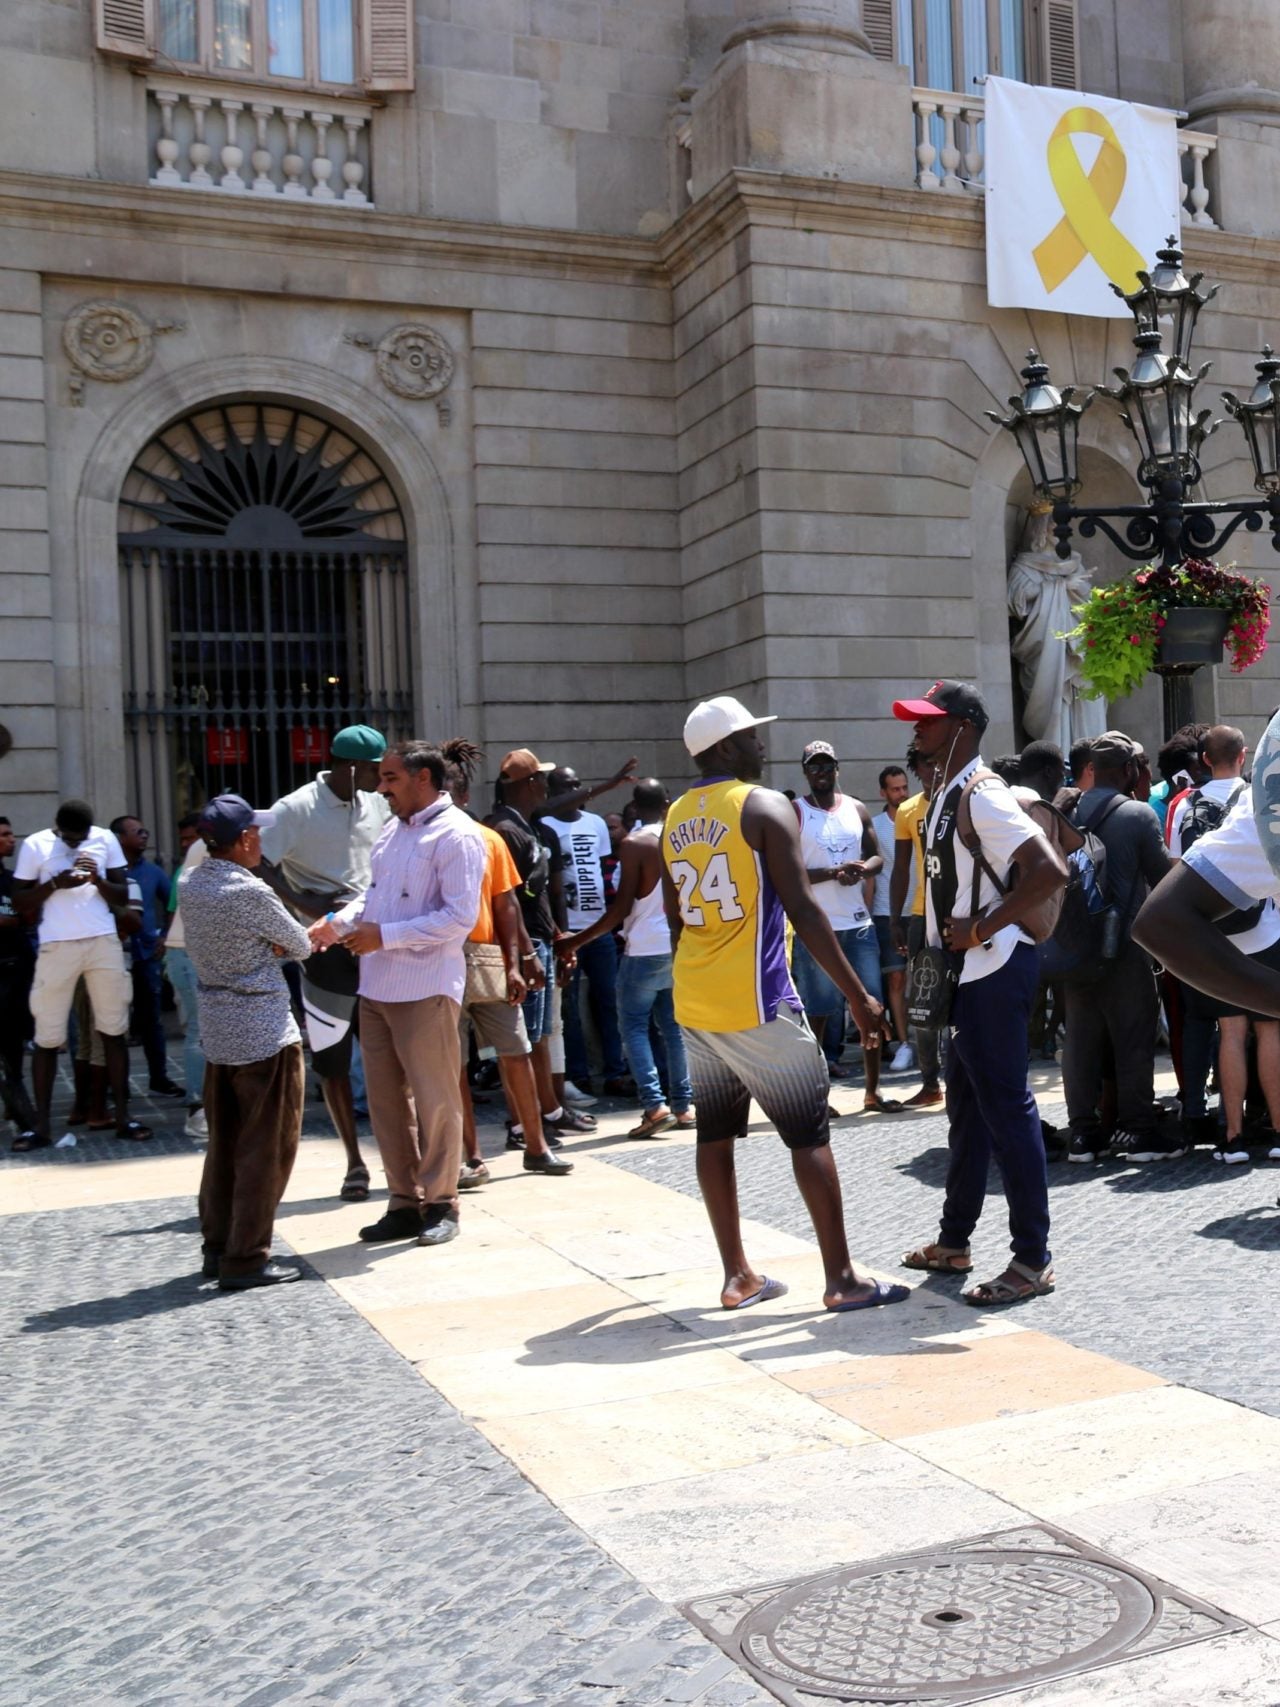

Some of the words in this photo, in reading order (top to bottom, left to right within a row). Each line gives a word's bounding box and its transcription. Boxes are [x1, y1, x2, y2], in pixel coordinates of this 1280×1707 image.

[669, 817, 729, 854] BRYANT
[578, 867, 603, 912] PHILIPP
[670, 852, 745, 927] 24
